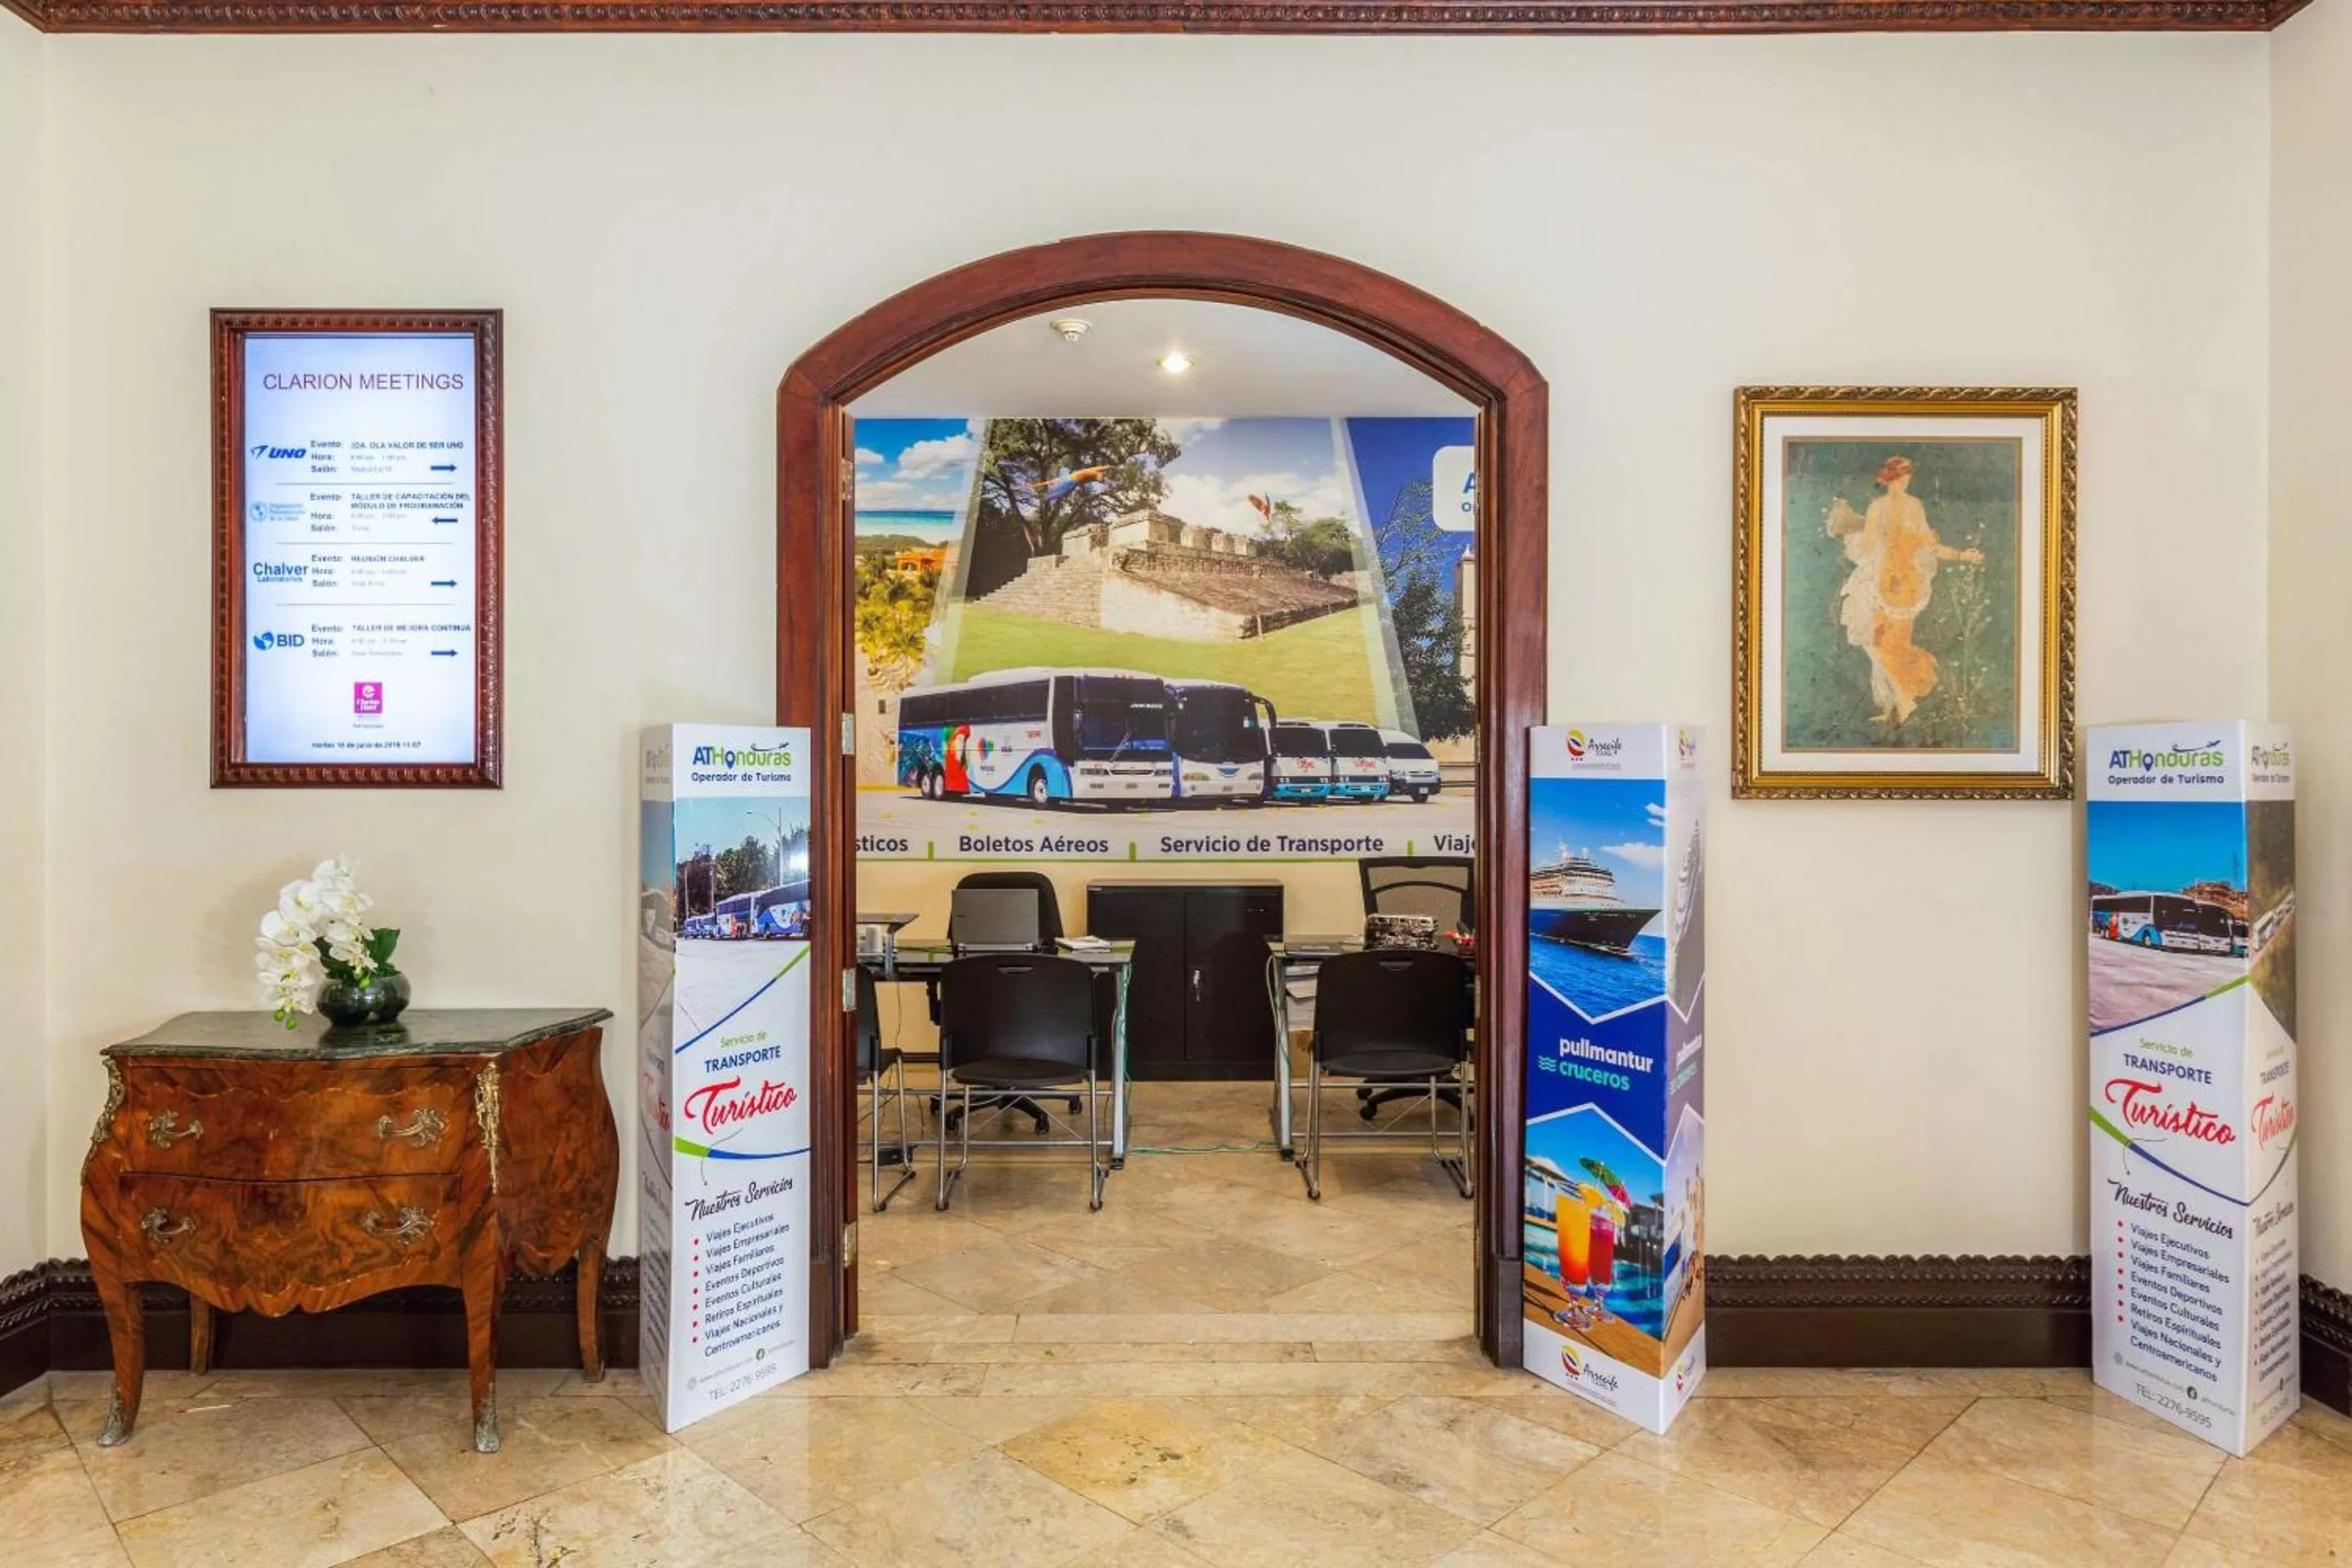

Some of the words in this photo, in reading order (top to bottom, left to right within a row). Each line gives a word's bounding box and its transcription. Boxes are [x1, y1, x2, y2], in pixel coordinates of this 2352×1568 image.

[263, 373, 352, 390] CLARION
[359, 373, 464, 390] MEETINGS
[268, 448, 307, 459] UNO
[311, 452, 335, 461] Hora:
[311, 465, 338, 473] Salón:
[351, 492, 382, 501] TALLER
[311, 511, 335, 519] Hora:
[253, 561, 309, 576] Chalver
[276, 634, 305, 648] BID
[693, 743, 791, 769] ATHonduras
[2109, 745, 2224, 772] ATHonduras
[691, 772, 737, 783] Operador
[742, 773, 752, 782] de
[755, 772, 791, 782] Turismo
[2108, 774, 2156, 786] Operador
[2160, 774, 2174, 783] de
[2177, 774, 2225, 784] Turismo
[959, 835, 1034, 853] Boletos
[1040, 835, 1109, 853] Aéreos
[1160, 835, 1242, 853] Servicio
[1245, 835, 1271, 853] de
[1276, 835, 1384, 855] Transporte
[719, 1033, 755, 1048] Servicio
[756, 1031, 767, 1041] de
[1559, 1036, 1654, 1073] pullmantur
[2138, 1037, 2178, 1055] Servicio
[2180, 1047, 2193, 1058] de
[704, 1045, 782, 1073] TRANSPORTE
[2123, 1054, 2212, 1085] TRANSPORTE
[1558, 1060, 1630, 1091] cruceros
[684, 1076, 797, 1135] Turístico
[2105, 1078, 2237, 1144] Turístico
[685, 1189, 742, 1222] Nuestros
[745, 1177, 793, 1204] Servicios
[2107, 1178, 2169, 1217] Nuestros
[2172, 1201, 2234, 1240] Servicios
[706, 1228, 731, 1242] Viajes
[733, 1213, 774, 1235] Ejecutivos
[706, 1244, 731, 1258] Viajes
[733, 1223, 791, 1250] Empresariales
[2131, 1223, 2158, 1241] Viajes
[2161, 1233, 2210, 1259] Ejecutivos
[705, 1273, 739, 1292] Eventos
[742, 1257, 785, 1283] Deportivos
[706, 1260, 731, 1274] Viajes
[733, 1245, 775, 1266] Familiares
[2131, 1239, 2158, 1258] Viajes
[2161, 1250, 2230, 1283] Empresariales
[2131, 1254, 2158, 1274] Viajes
[2161, 1267, 2210, 1293] Familiares
[705, 1290, 739, 1307] Eventos
[742, 1272, 782, 1294] Culturales
[2130, 1271, 2168, 1294] Eventos
[2169, 1286, 2223, 1316] Deportivos
[705, 1307, 734, 1324] Retiros
[737, 1288, 784, 1312] Espirituales
[2130, 1287, 2168, 1311] Eventos
[2169, 1303, 2220, 1331] Culturales
[705, 1325, 731, 1340] Viajes
[733, 1307, 777, 1329] Nacionales
[705, 1319, 782, 1357] Centroamericanos
[2130, 1303, 2163, 1325] Retiros
[2165, 1317, 2221, 1349] Espirituales
[2130, 1318, 2158, 1340] Viajes
[2160, 1332, 2213, 1363] Nacionales
[2130, 1335, 2217, 1383] Centroamericanos
